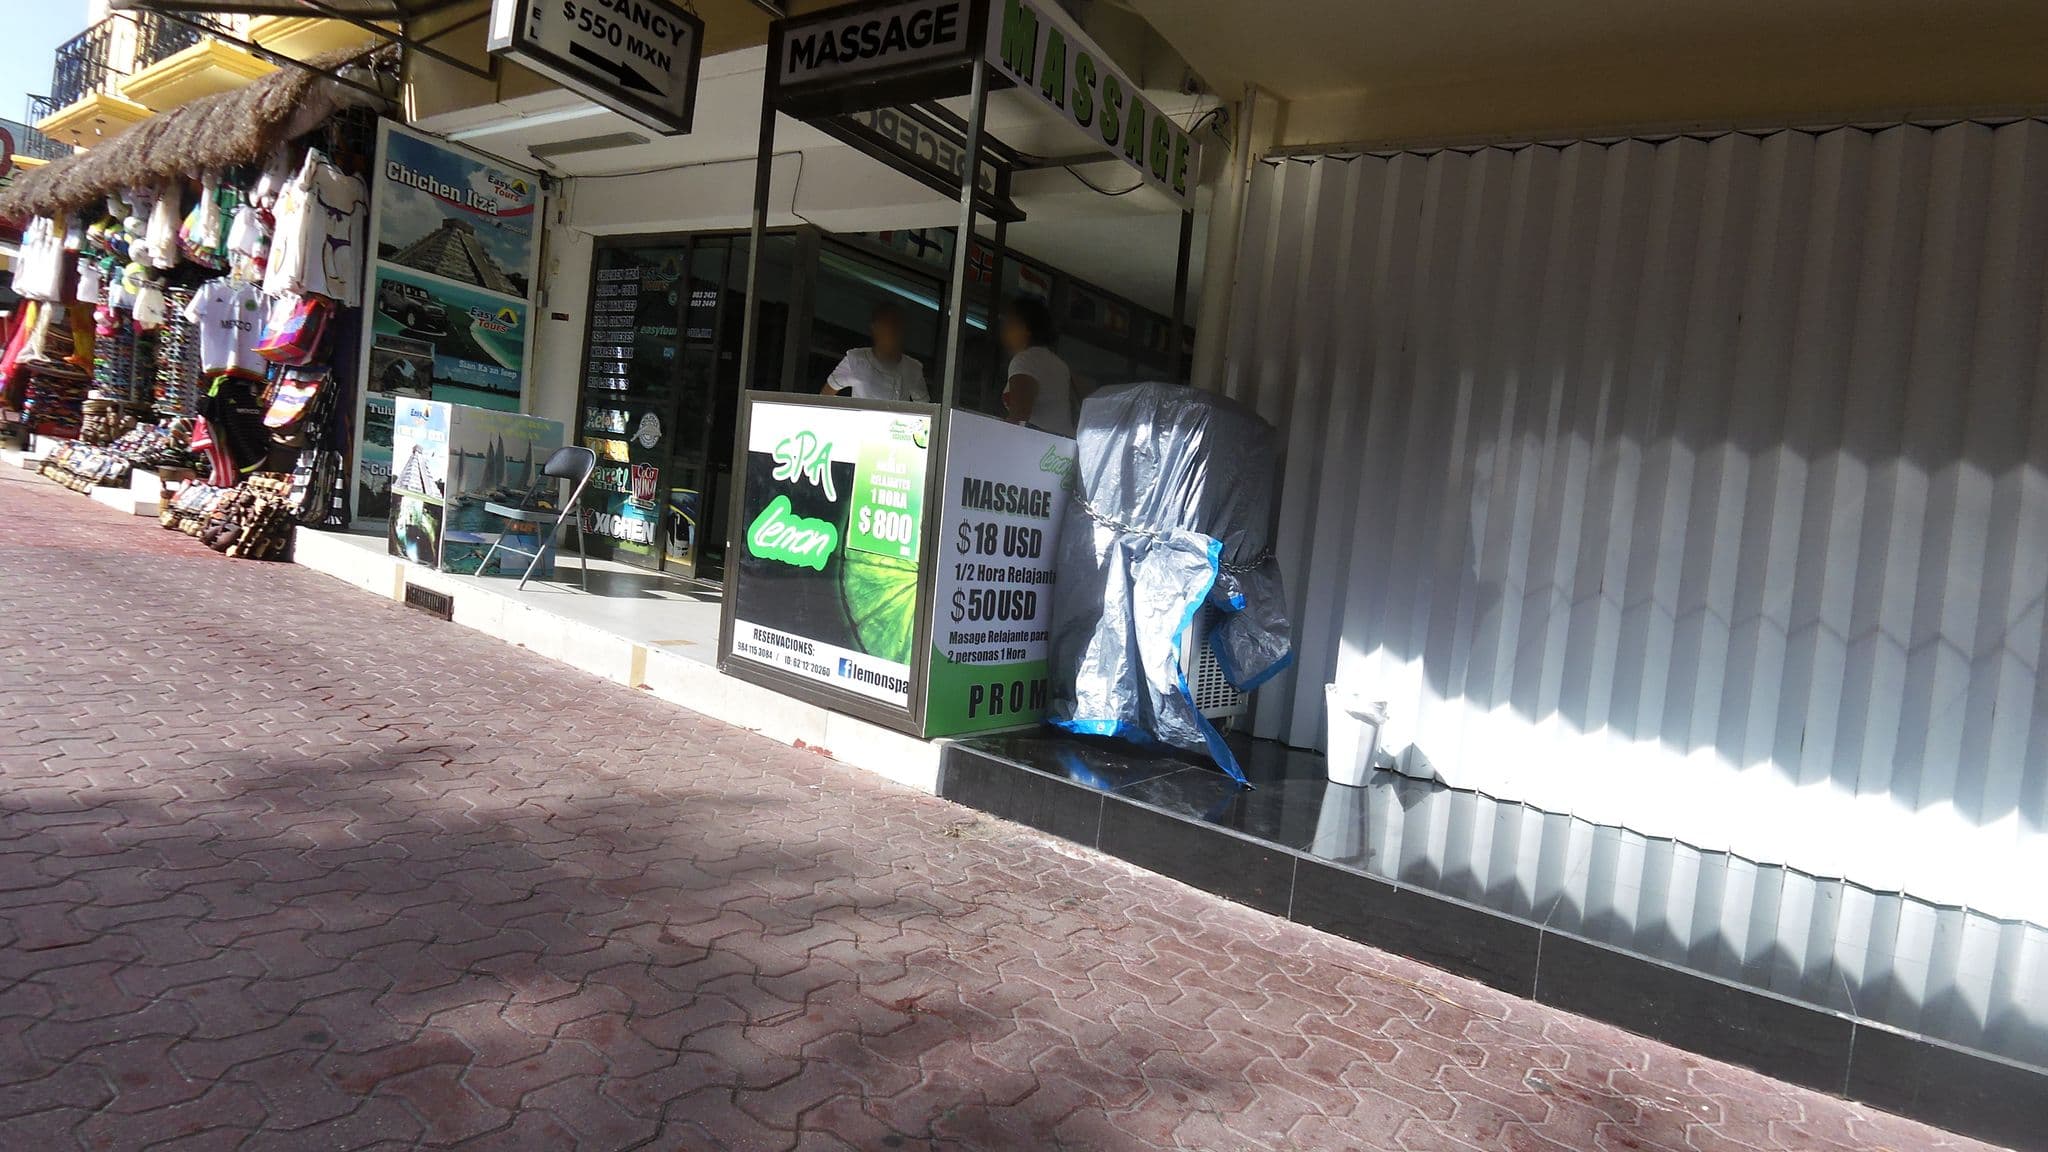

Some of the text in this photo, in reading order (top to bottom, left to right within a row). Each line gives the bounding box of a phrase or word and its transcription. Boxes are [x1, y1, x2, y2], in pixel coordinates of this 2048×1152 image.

[600, 0, 685, 46] ANCY
[789, 3, 960, 73] MASSAGE
[626, 34, 671, 72] MXN
[1001, 0, 1190, 196] MASSAGE
[387, 161, 461, 202] Chichen
[488, 174, 511, 190] Easy
[494, 186, 519, 202] Tours
[470, 306, 496, 321] Easy
[479, 319, 507, 333] Tours
[772, 430, 837, 502] SPA
[961, 477, 1052, 519] MASSAGE
[751, 502, 833, 560] lemon
[1003, 525, 1042, 558] USD
[955, 563, 974, 582] 1/2
[977, 565, 1005, 583] Hora
[753, 628, 815, 657] RESERVACIONES:
[949, 629, 1049, 645] Masage Relajante para
[947, 650, 954, 664] 2
[955, 649, 1000, 665] personas
[1006, 648, 1026, 660] Hora
[968, 678, 1048, 719] PROM
